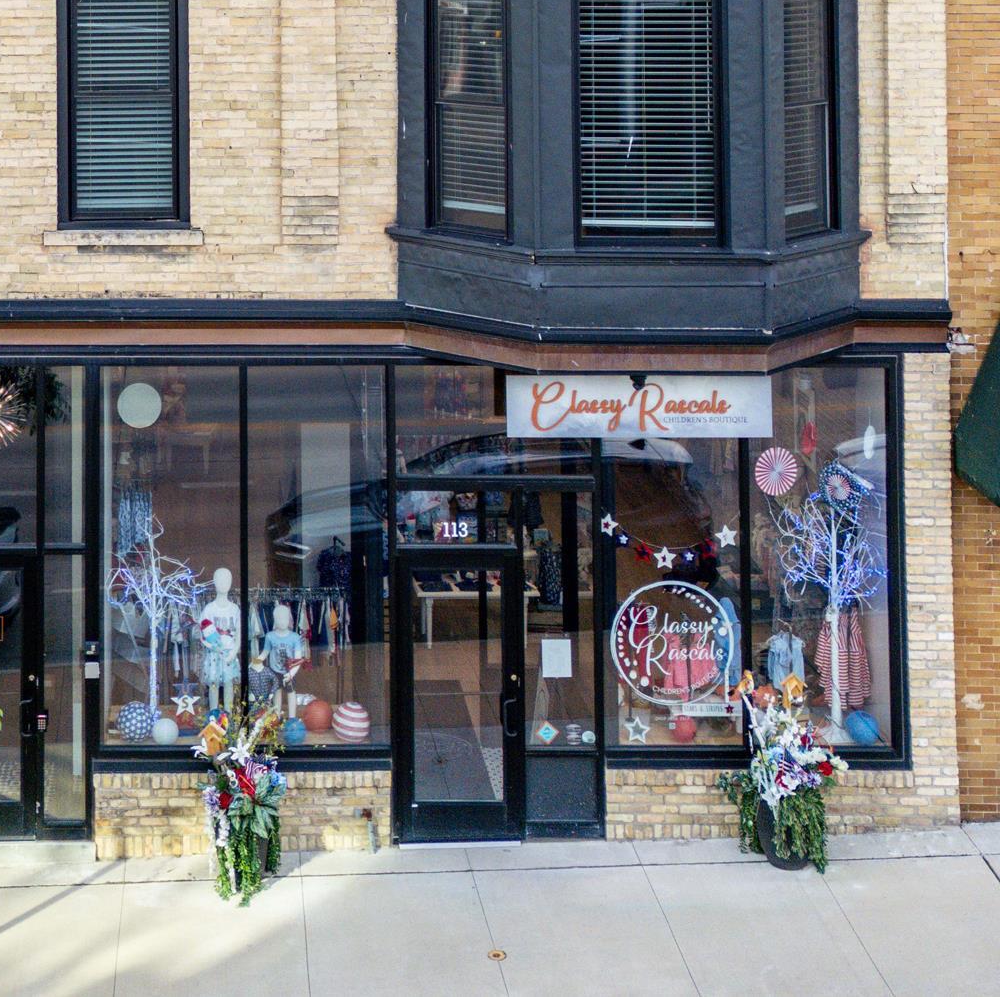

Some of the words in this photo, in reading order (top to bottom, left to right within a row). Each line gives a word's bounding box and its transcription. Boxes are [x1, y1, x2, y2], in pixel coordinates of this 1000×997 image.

[531, 381, 627, 432] Classy
[628, 382, 731, 432] Rascals
[663, 416, 708, 424] CHILDREN'S
[709, 416, 748, 424] BOUTIQUE
[443, 521, 468, 538] 113
[628, 605, 714, 649] Classy
[636, 634, 727, 676] Rascals
[652, 685, 691, 696] CHILDREN'S
